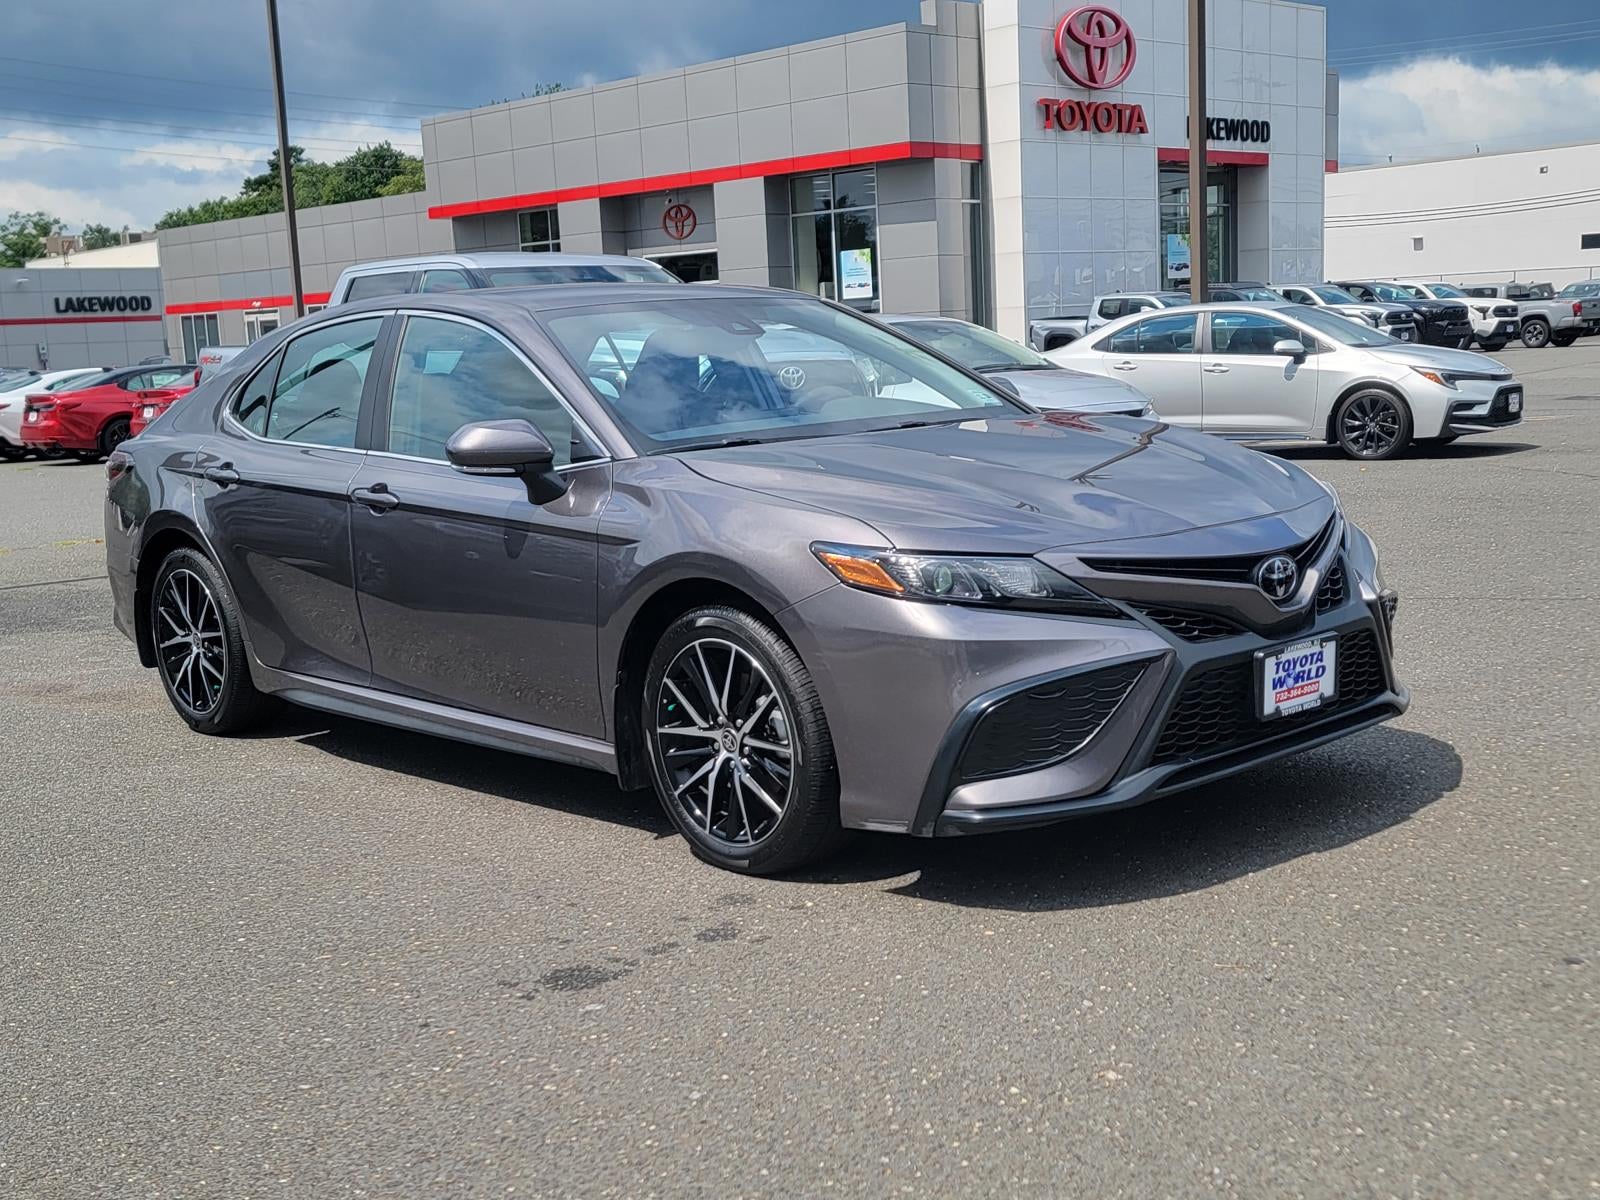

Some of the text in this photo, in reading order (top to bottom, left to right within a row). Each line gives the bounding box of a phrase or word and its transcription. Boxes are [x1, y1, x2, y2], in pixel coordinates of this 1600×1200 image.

[1037, 98, 1149, 134] TOYOTA
[1187, 116, 1270, 143] KEWOOD
[54, 295, 152, 313] LAKEWOOD
[1274, 650, 1324, 675] TOYOTA
[1281, 704, 1303, 717] TOYOTA
